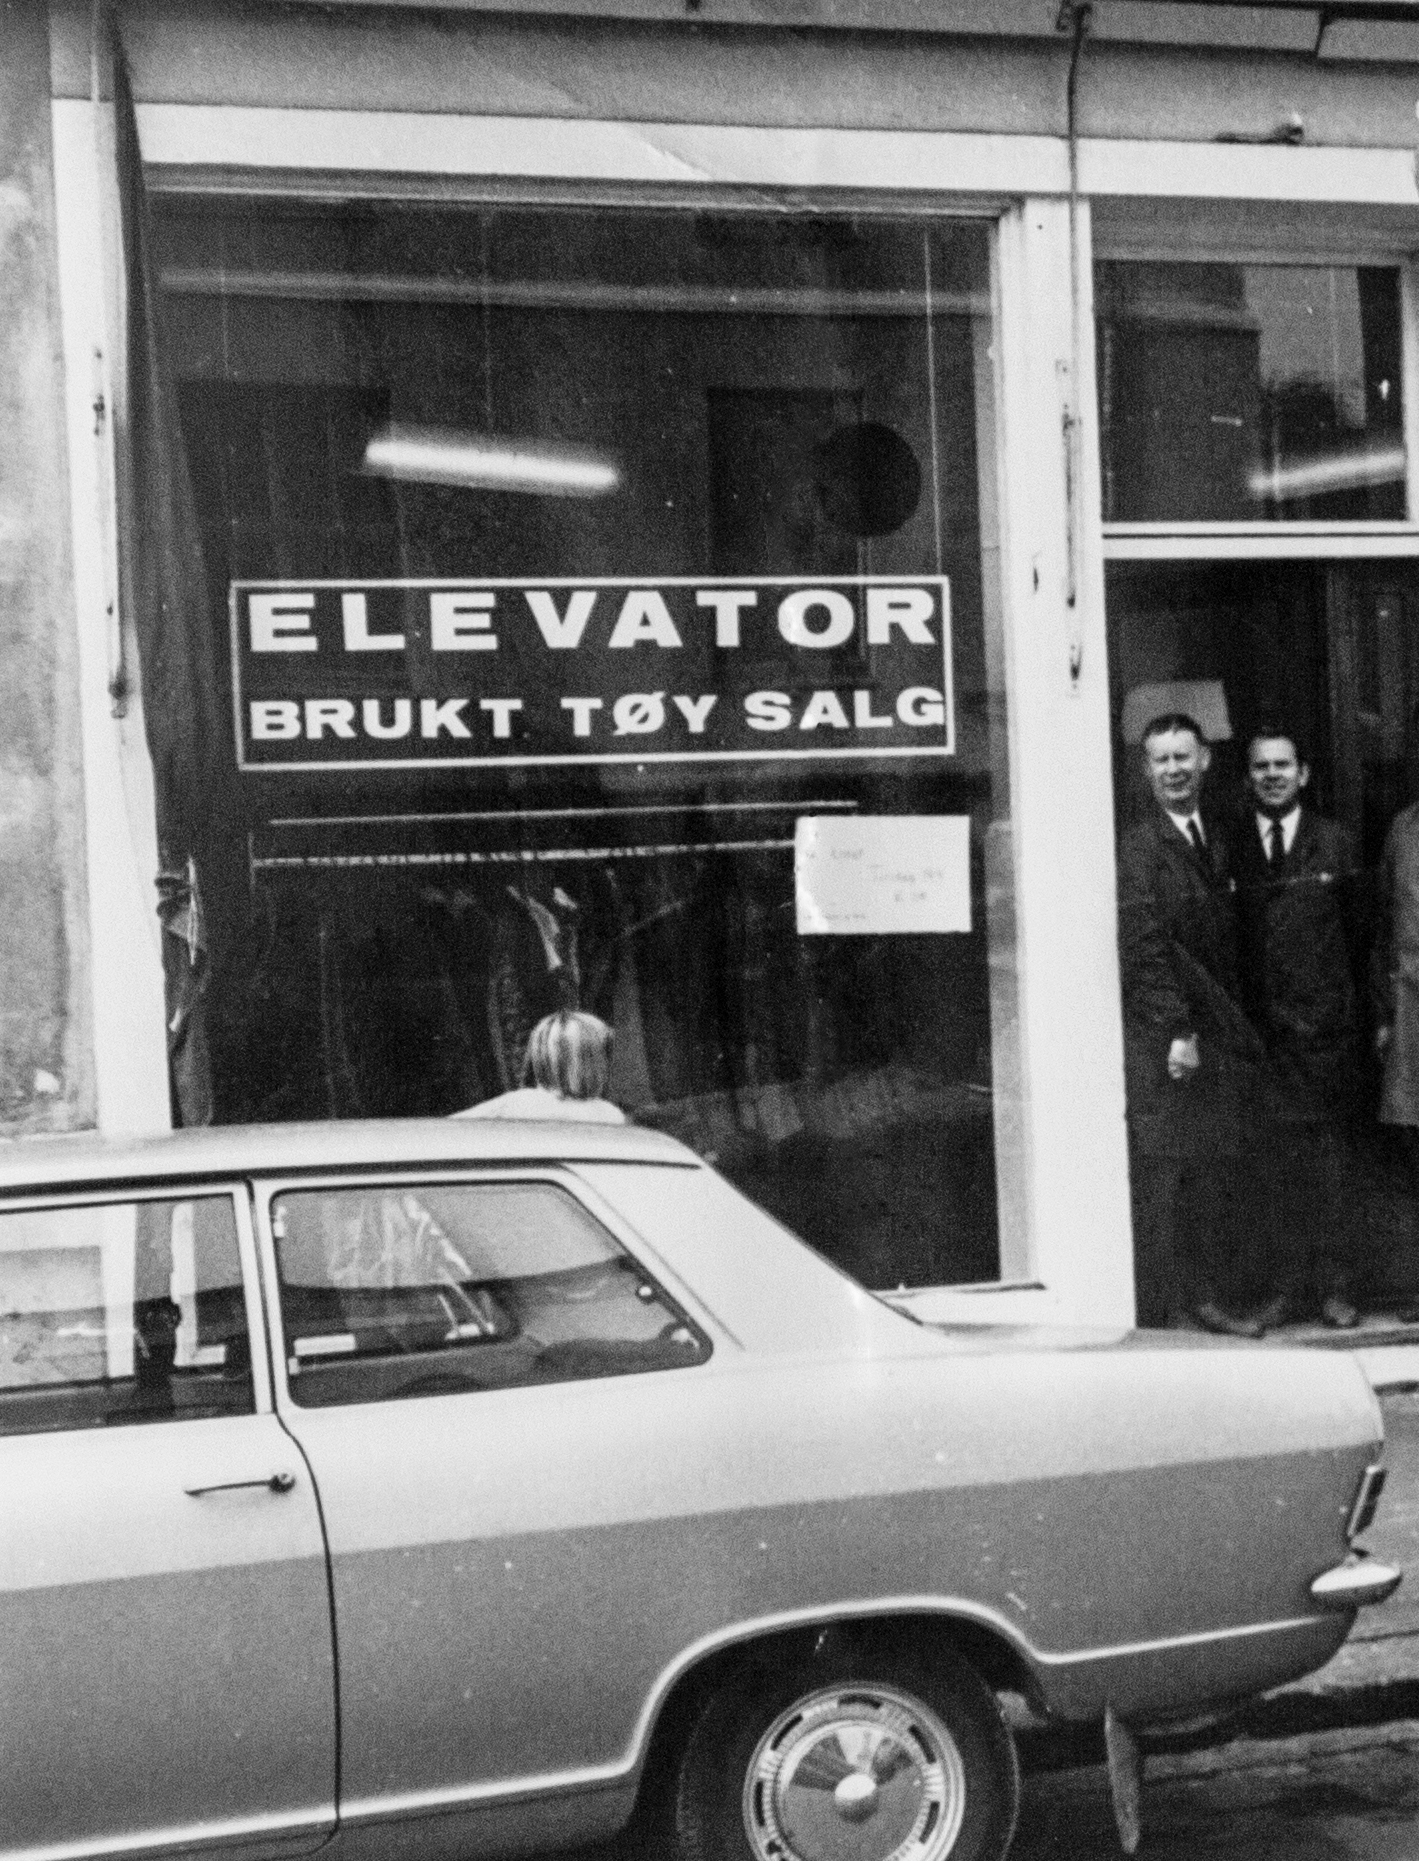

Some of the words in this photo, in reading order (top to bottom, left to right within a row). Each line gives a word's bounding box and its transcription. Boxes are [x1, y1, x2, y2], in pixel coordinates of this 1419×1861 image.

[247, 587, 937, 654] ELEVATOR
[249, 697, 524, 741] BRUKT
[560, 690, 719, 738] TØY
[742, 686, 948, 732] SALG
